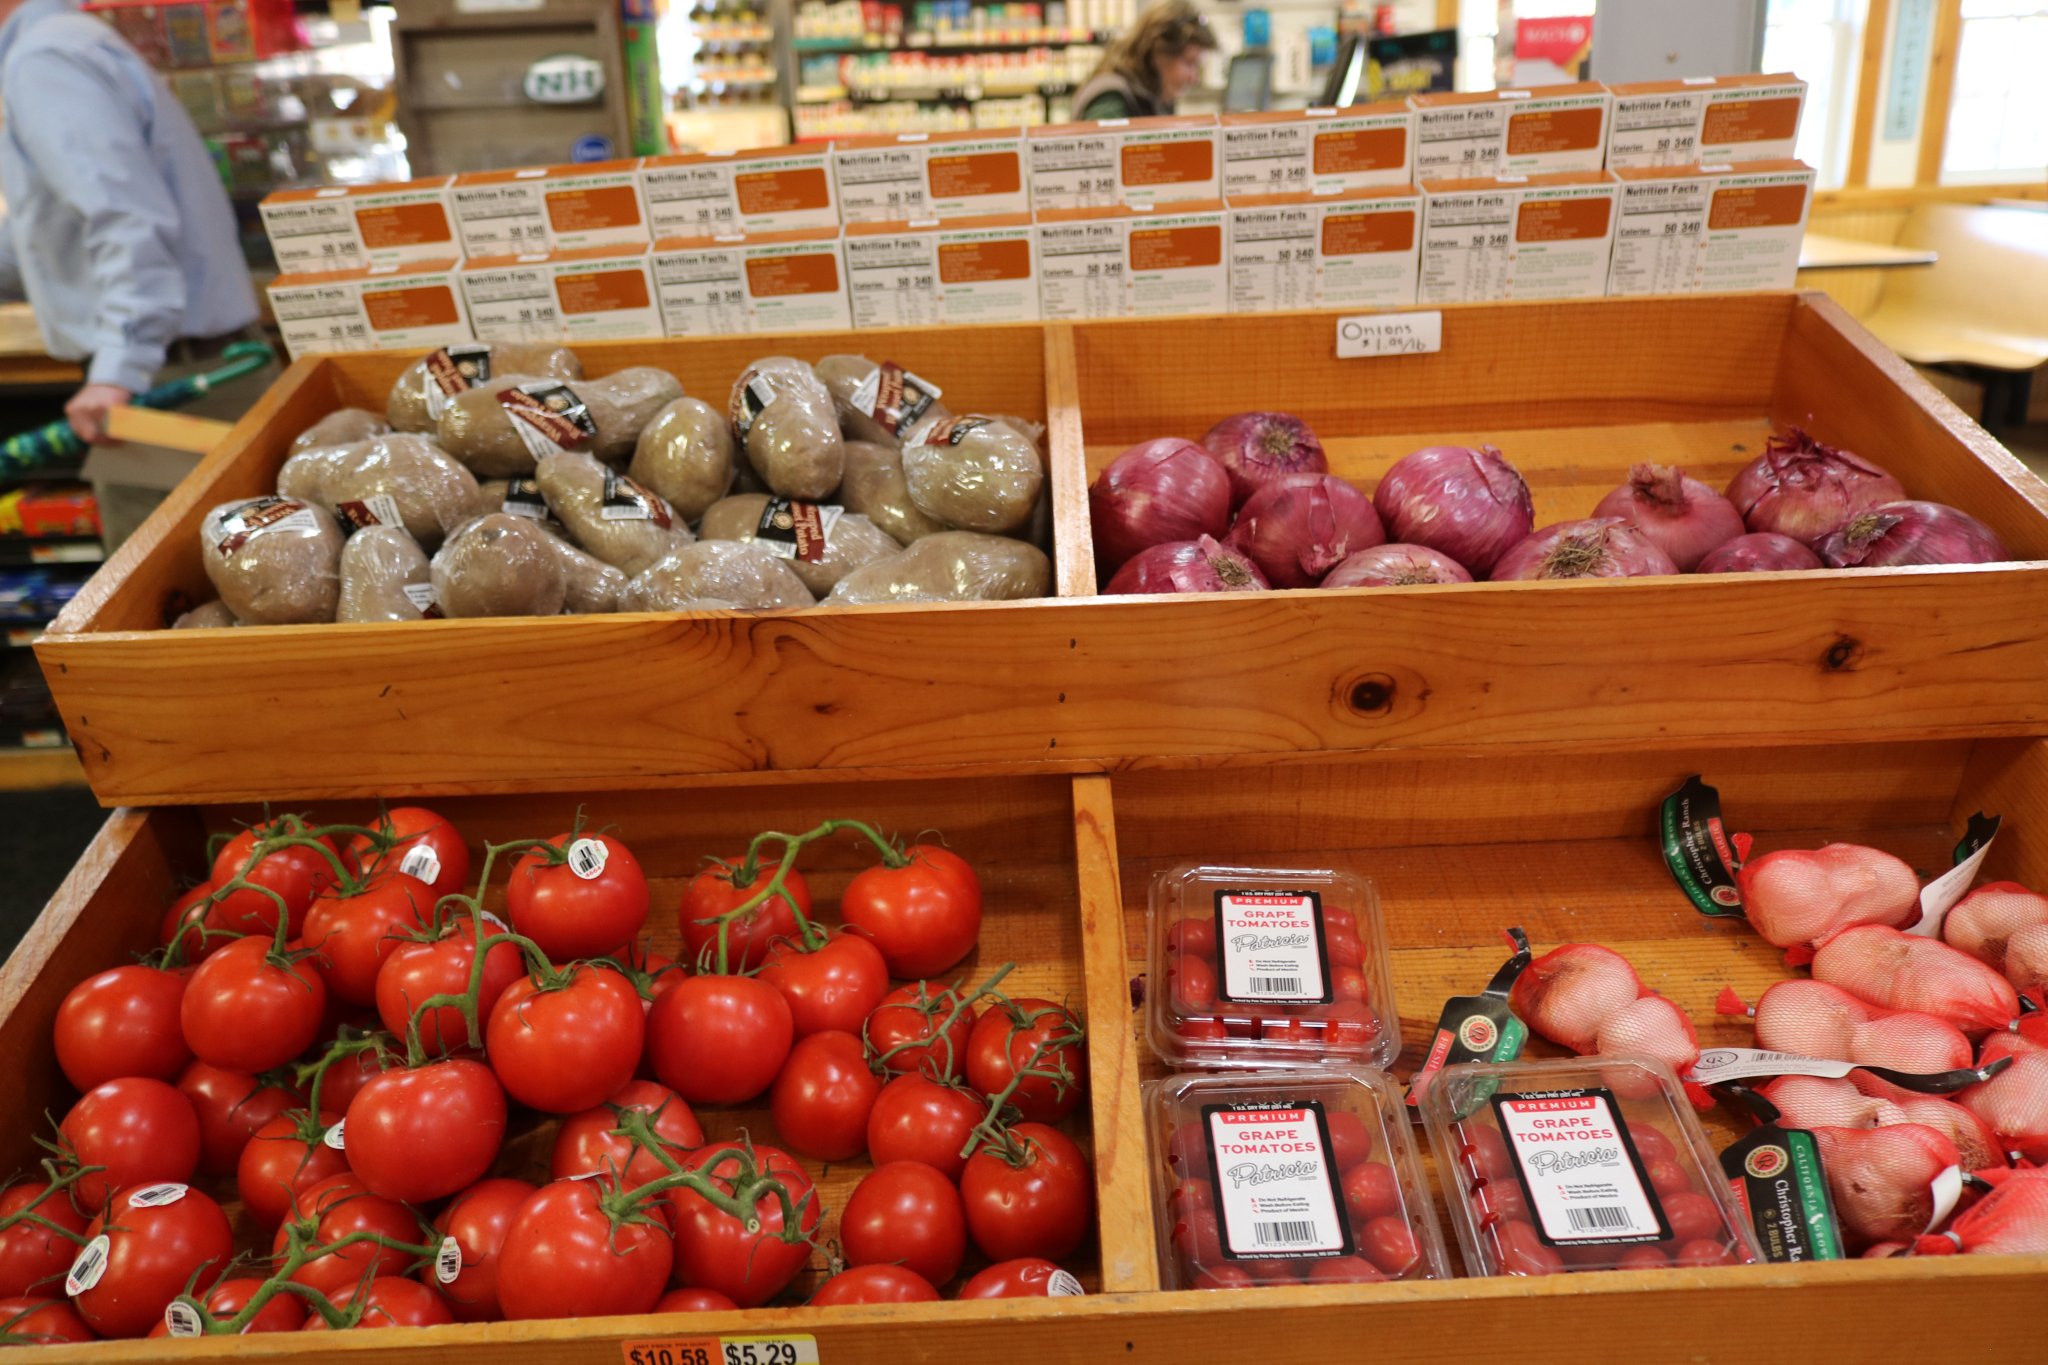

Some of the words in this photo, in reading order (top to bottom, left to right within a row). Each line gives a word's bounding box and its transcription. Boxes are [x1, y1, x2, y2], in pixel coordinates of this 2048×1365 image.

[536, 69, 595, 97] NH
[1617, 100, 1661, 112] Nutrition
[1664, 98, 1692, 109] Facts
[1421, 111, 1463, 124] Nutrition
[1467, 109, 1494, 120] Facts
[1226, 130, 1267, 143] Nutrition
[1271, 128, 1297, 139] Facts
[1032, 142, 1074, 154] Nutrition
[1078, 140, 1104, 150] Facts
[1657, 139, 1670, 150] 50
[1673, 137, 1693, 148] 340
[1464, 149, 1476, 160] 50
[1480, 147, 1499, 159] 340
[838, 154, 881, 167] Nutrition
[1626, 185, 1668, 197] Nutrition
[1671, 184, 1698, 194] Facts
[1431, 197, 1473, 209] Nutrition
[1477, 196, 1503, 206] Facts
[1235, 212, 1276, 224] Nutrition
[1280, 211, 1306, 221] Facts
[1041, 227, 1083, 238] Nutrition
[1086, 225, 1113, 235] Facts
[1664, 223, 1677, 233] 50
[1680, 221, 1700, 232] 340
[849, 241, 891, 252] Nutrition
[1472, 235, 1484, 246] 50
[1489, 234, 1508, 245] 340
[1342, 322, 1412, 340] Onions
[1682, 799, 1691, 828] Ranch
[1686, 831, 1712, 884] Christopher
[1228, 920, 1309, 928] TOMATOES
[1230, 934, 1309, 952] Patricia
[1517, 1100, 1590, 1110] PREMIUM
[1228, 1112, 1299, 1122] PREMIUM
[1532, 1118, 1592, 1129] GRAPE
[1239, 1130, 1298, 1140] GRAPE
[1516, 1129, 1613, 1142] TOMATOES
[1220, 1142, 1316, 1154] TOMATOES
[1528, 1147, 1618, 1176] Patricia
[1227, 1161, 1317, 1189] Patricia
[1796, 1145, 1818, 1212] CALIFORNIA
[1775, 1180, 1797, 1244] Christopher
[1768, 1229, 1784, 1258] BULBS
[726, 1343, 797, 1365] $5.29
